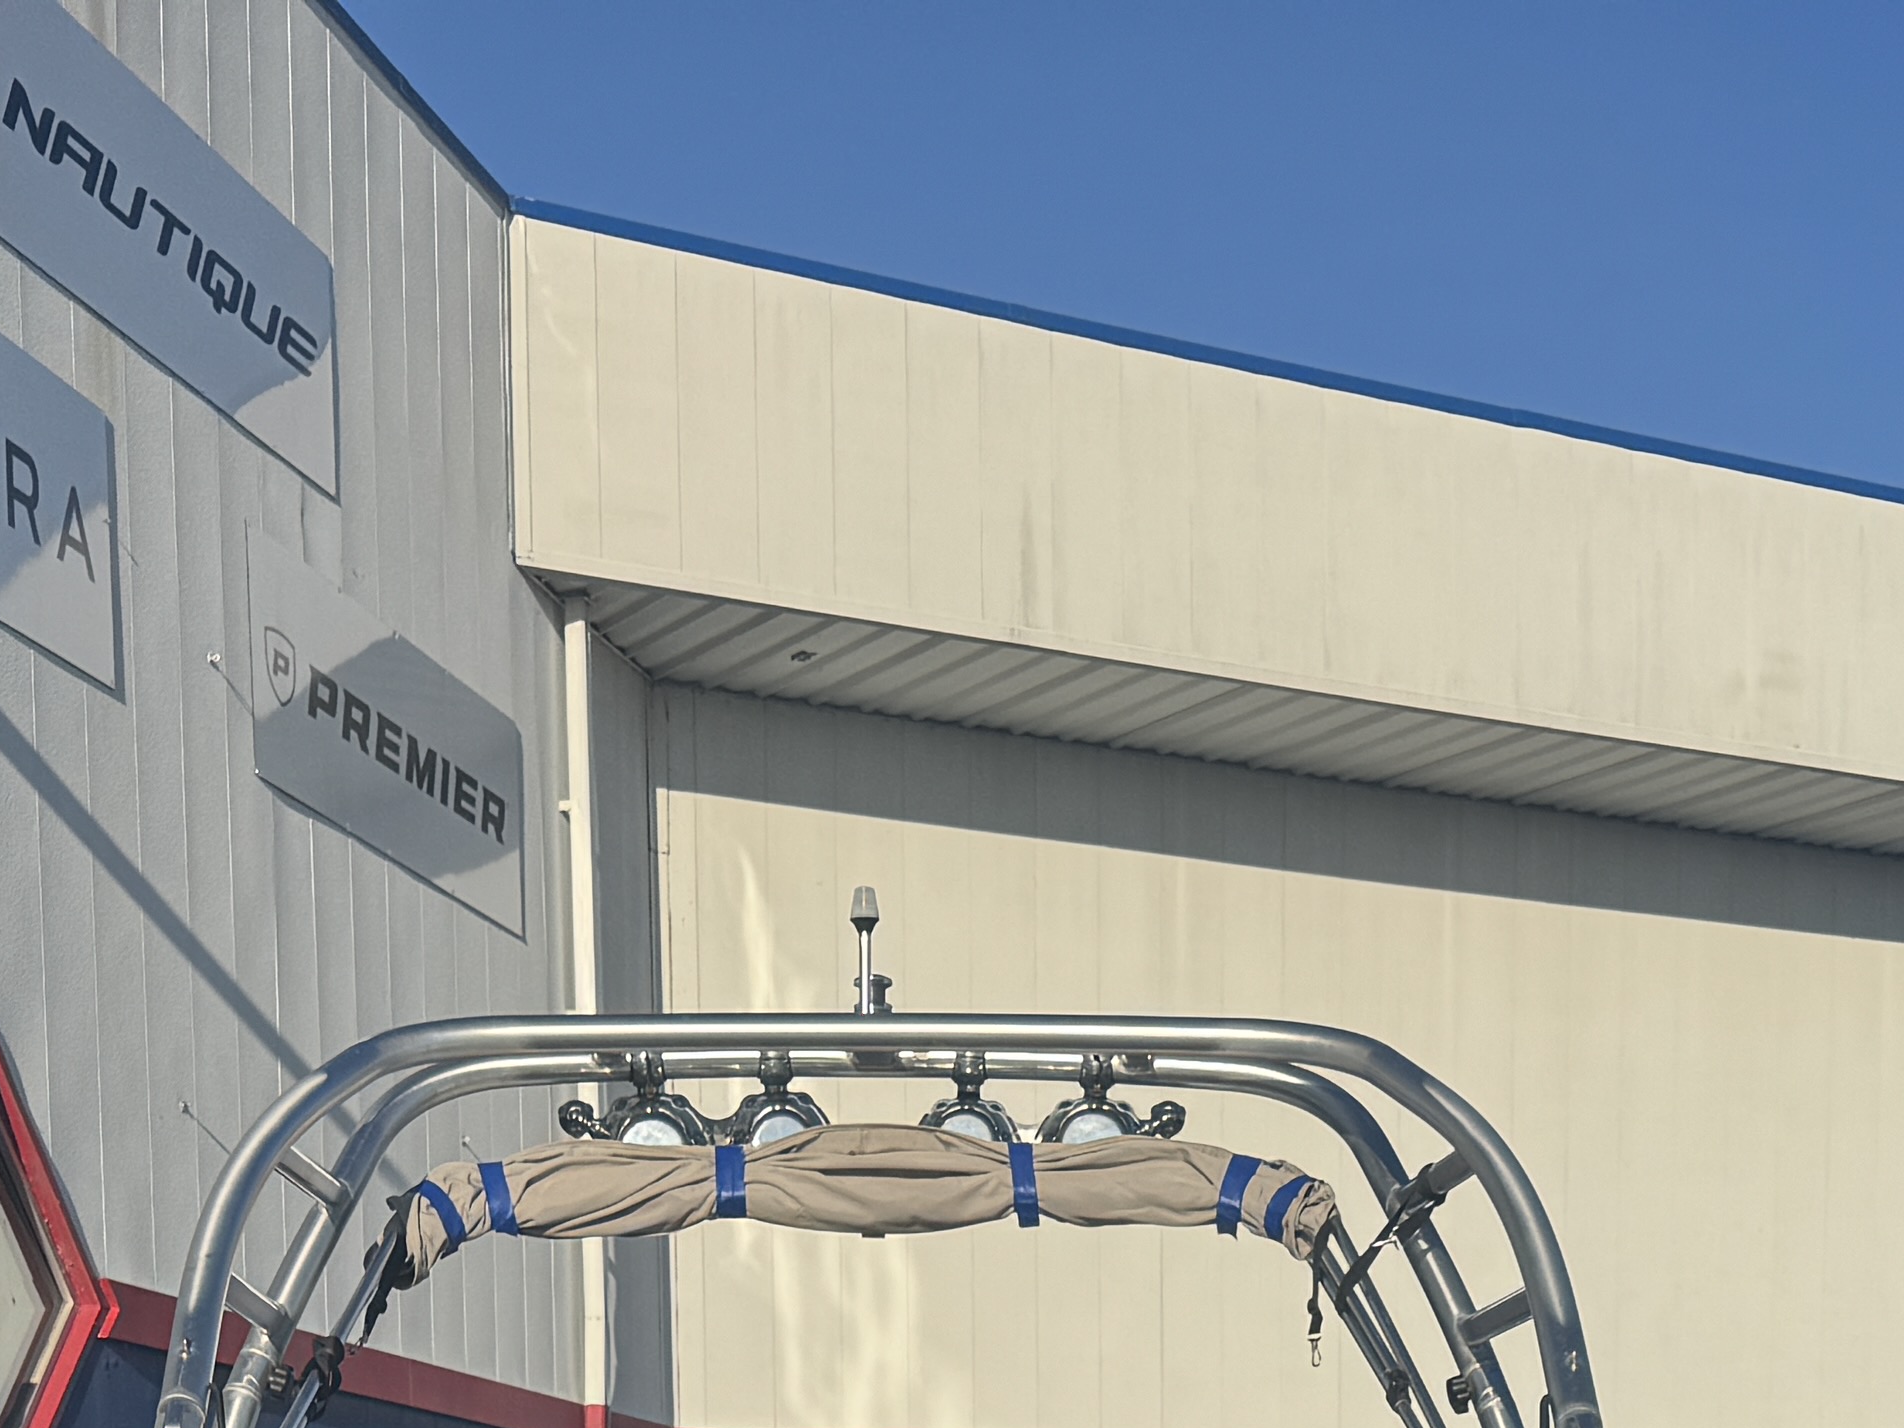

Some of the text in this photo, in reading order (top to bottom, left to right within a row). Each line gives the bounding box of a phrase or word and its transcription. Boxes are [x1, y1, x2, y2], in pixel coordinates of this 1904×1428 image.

[2, 77, 318, 378] NAUTIQUE
[272, 647, 290, 678] P
[307, 663, 506, 846] PREMIER
